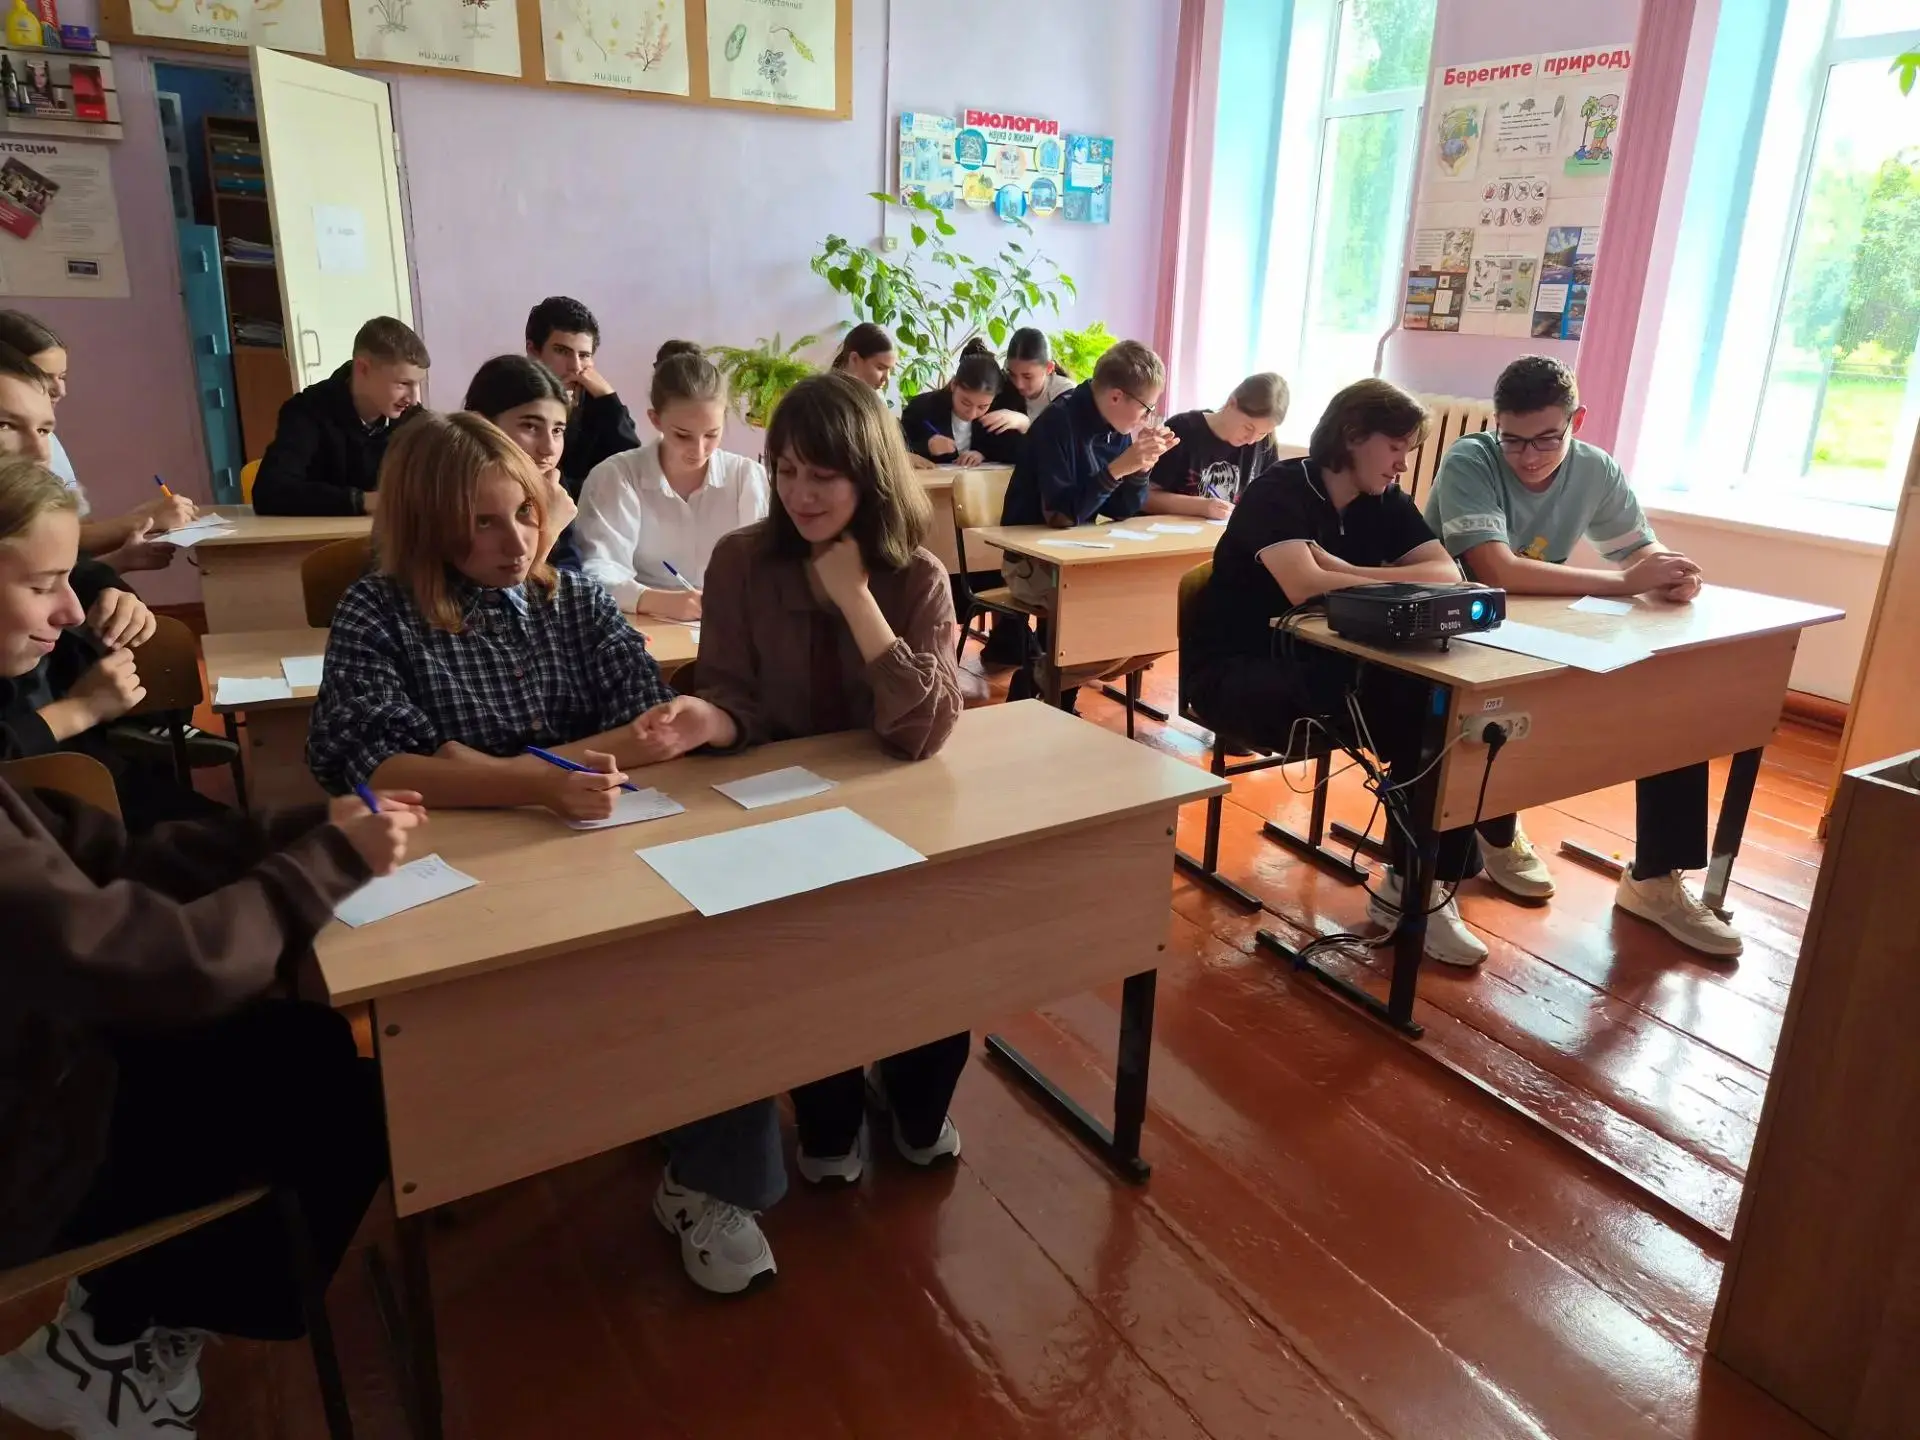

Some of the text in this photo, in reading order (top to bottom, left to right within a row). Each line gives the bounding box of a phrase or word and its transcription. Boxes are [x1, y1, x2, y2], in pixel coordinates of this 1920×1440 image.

[1443, 49, 1631, 88] Берегите природу
[966, 110, 1058, 135] БИОЛОГИЯ
[988, 130, 1006, 141] наука
[1014, 133, 1034, 143] жизни
